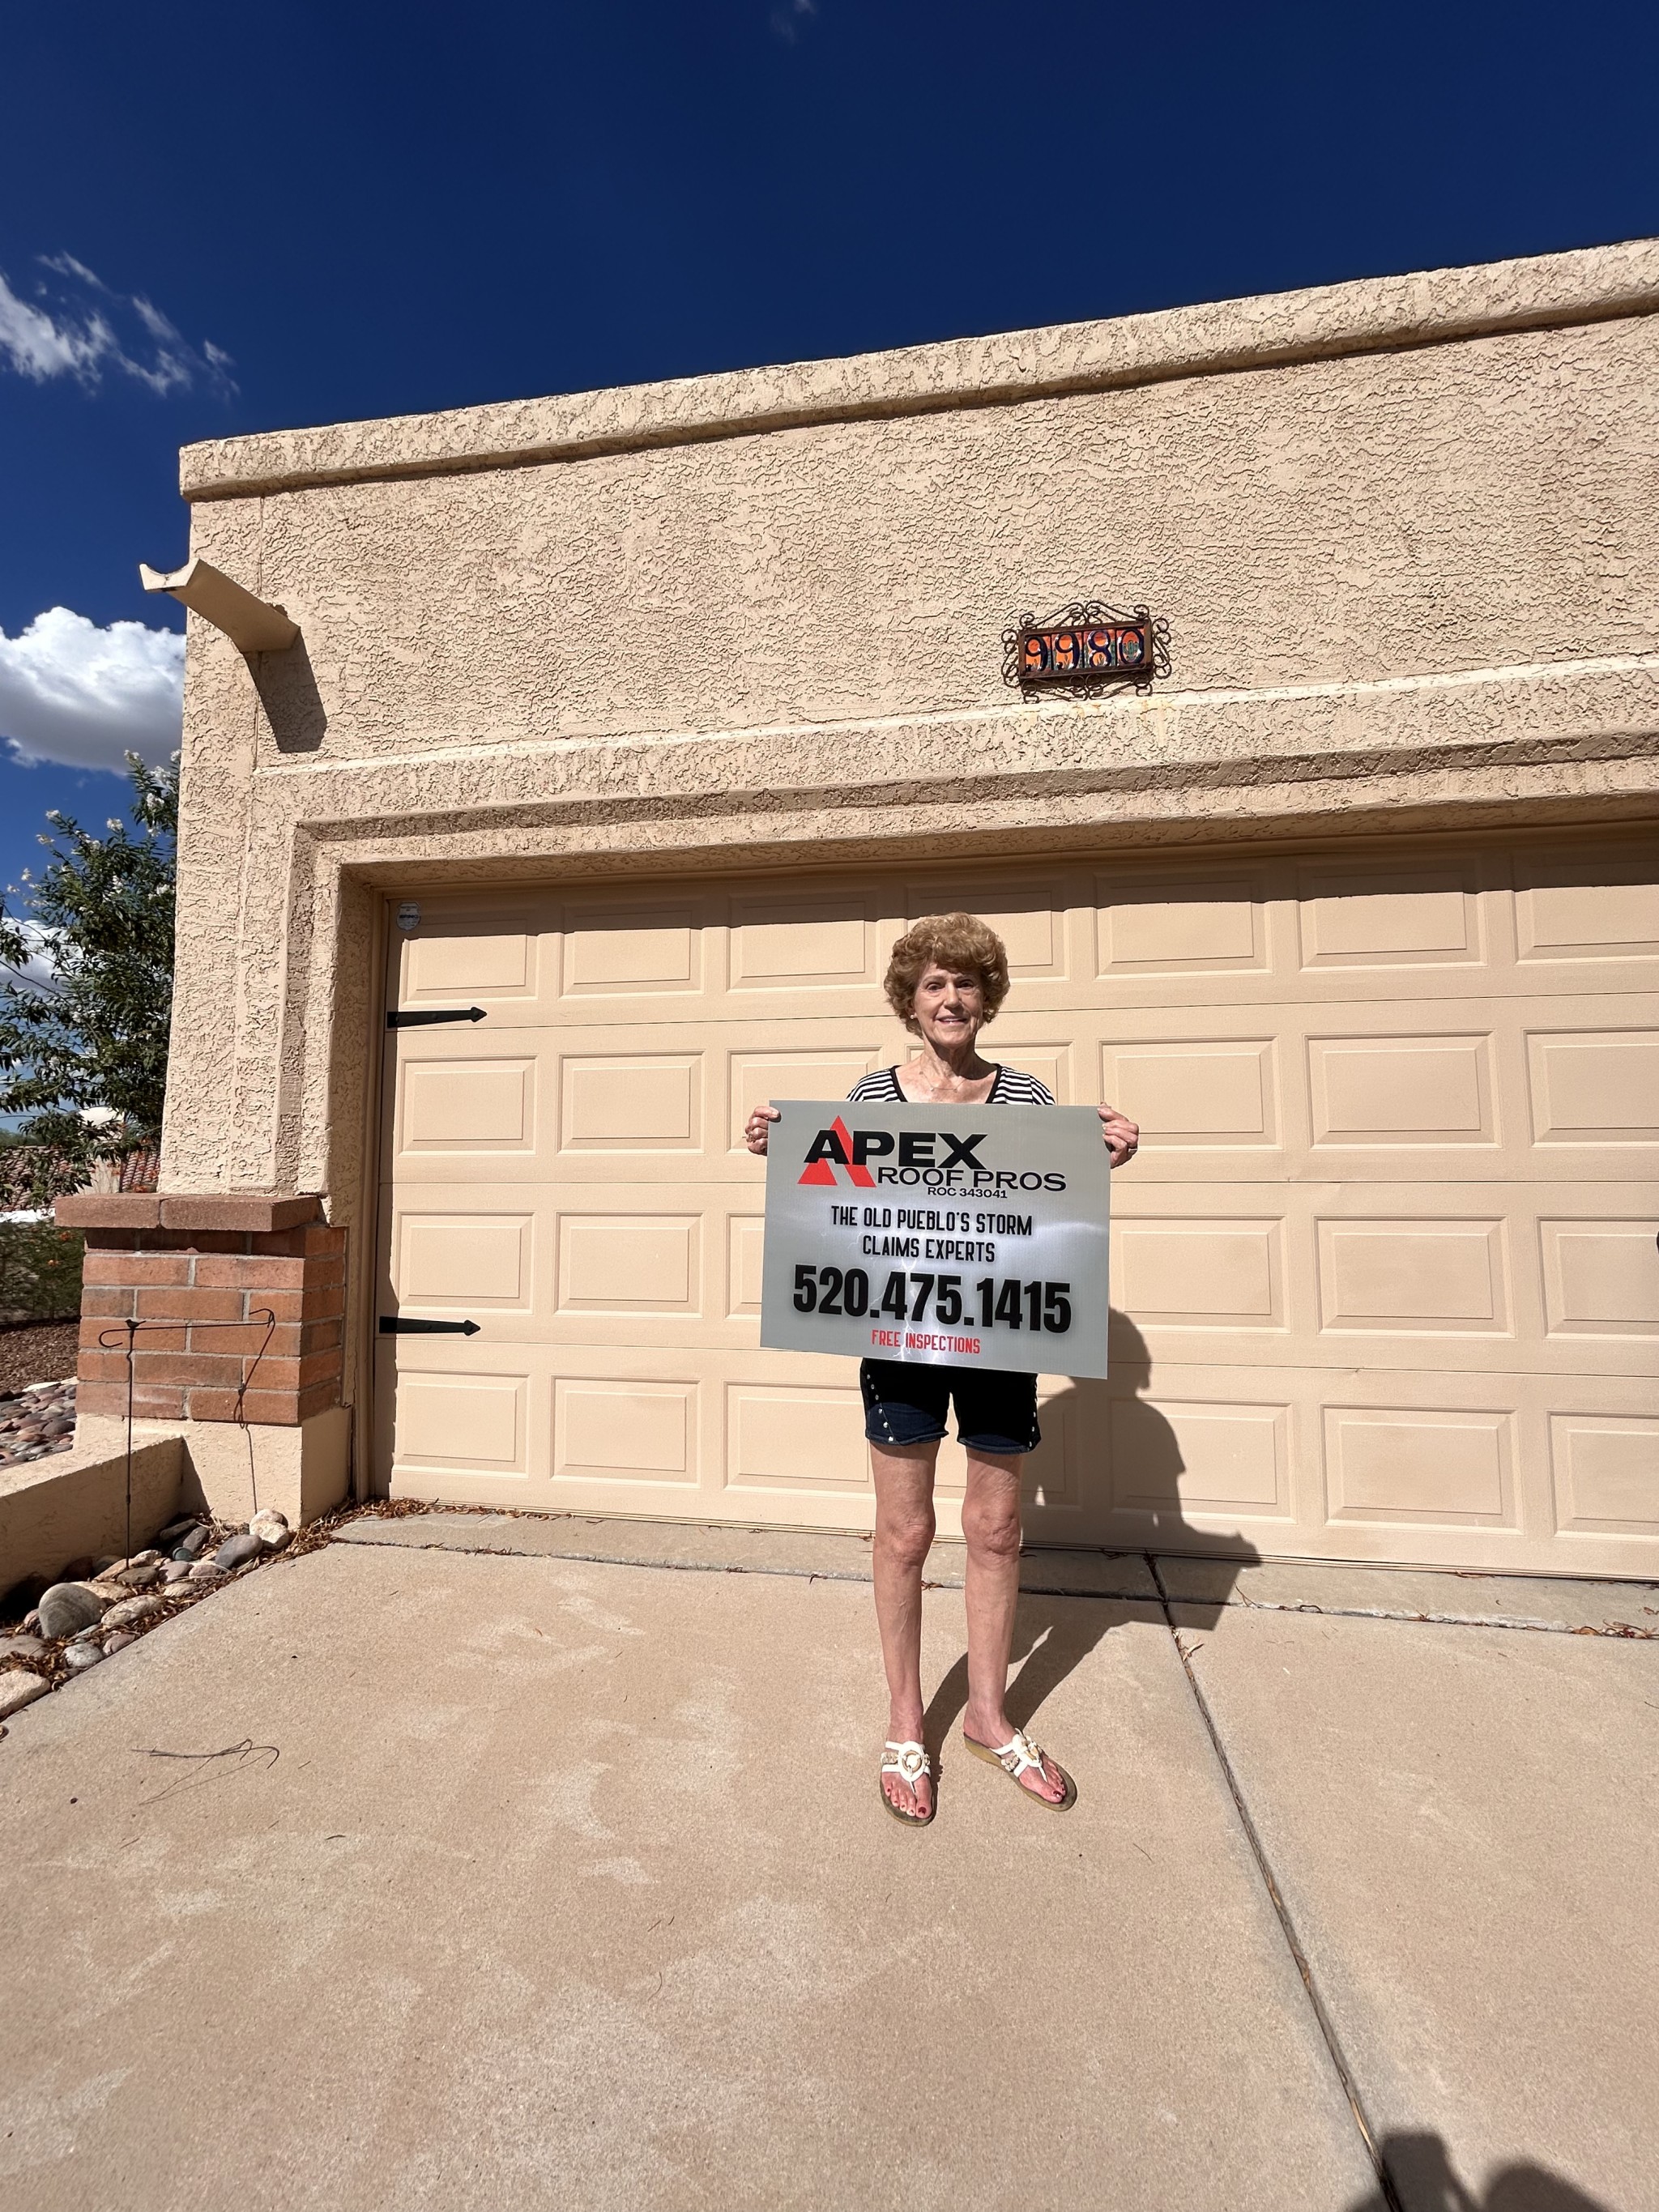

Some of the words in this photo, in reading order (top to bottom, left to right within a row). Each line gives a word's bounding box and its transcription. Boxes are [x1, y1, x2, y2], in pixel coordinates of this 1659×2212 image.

[1025, 629, 1145, 671] 9980
[804, 1129, 987, 1170] APEX
[878, 1166, 964, 1187] ROOF
[974, 1170, 1067, 1192] PROS
[928, 1187, 957, 1197] ROC
[959, 1188, 1008, 1199] 343041
[831, 1205, 858, 1225] THE
[864, 1207, 891, 1228] OLD
[897, 1209, 970, 1231] PUEBLO'S
[976, 1214, 1033, 1236] STORM
[863, 1236, 919, 1257] CLAIMS
[926, 1239, 996, 1262] EXPERTS
[793, 1264, 1071, 1333] 520.475.1415
[872, 1330, 901, 1347] FREE
[906, 1333, 981, 1353] INSPECTIONS
